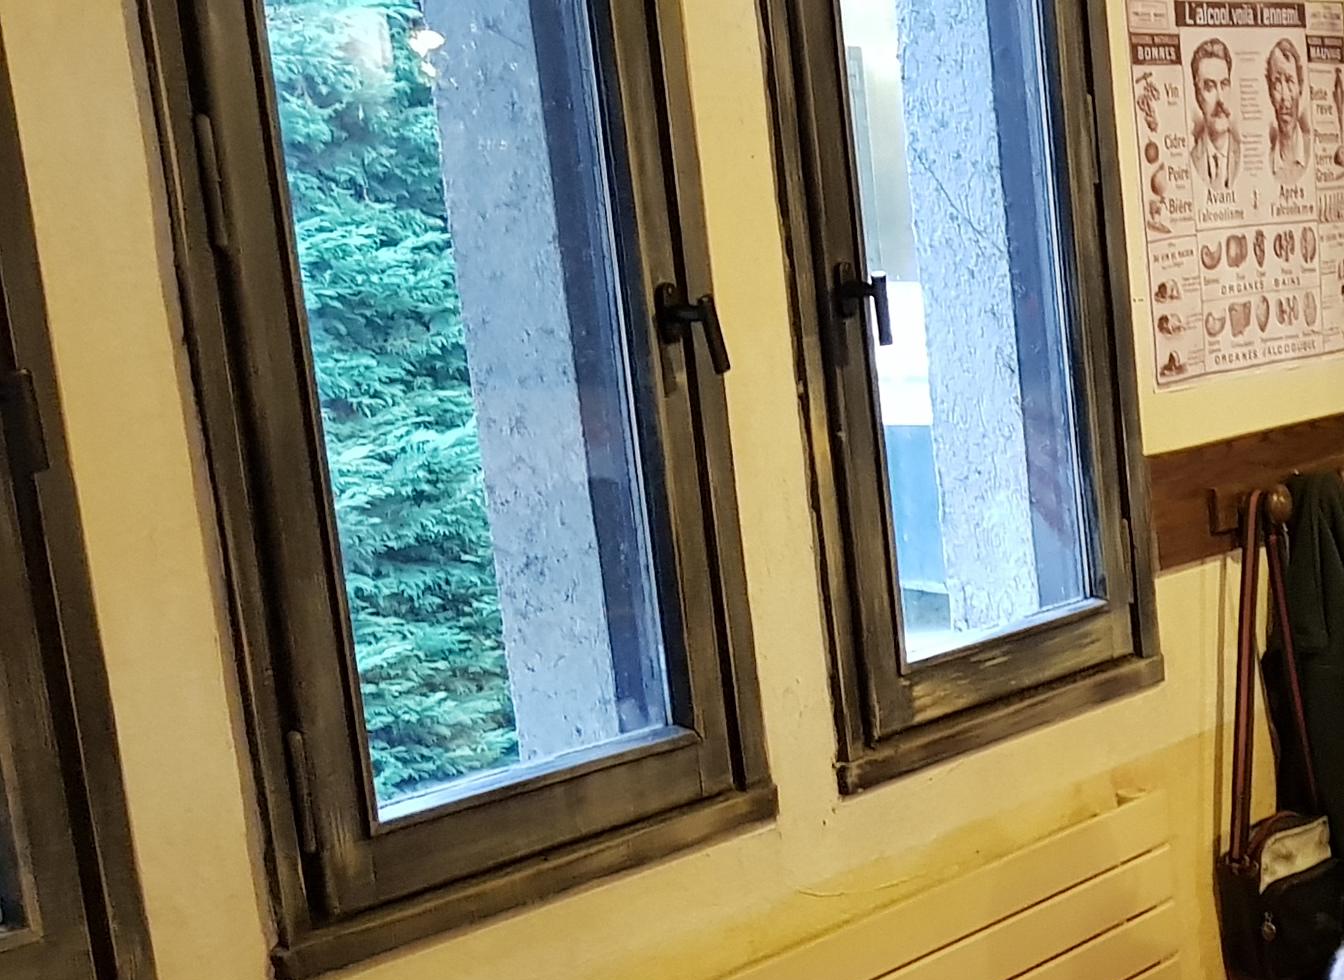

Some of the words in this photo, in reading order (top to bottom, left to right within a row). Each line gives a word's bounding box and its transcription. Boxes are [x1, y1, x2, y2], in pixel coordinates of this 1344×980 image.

[1136, 45, 1176, 61] BONNES
[1164, 83, 1180, 99] Vin
[1164, 132, 1187, 151] Cidre
[1207, 188, 1236, 205] Avant
[1280, 184, 1304, 204] Après
[1169, 198, 1193, 215] Bière
[1221, 281, 1264, 295] ORGANES
[1214, 350, 1259, 366] ORGANES
